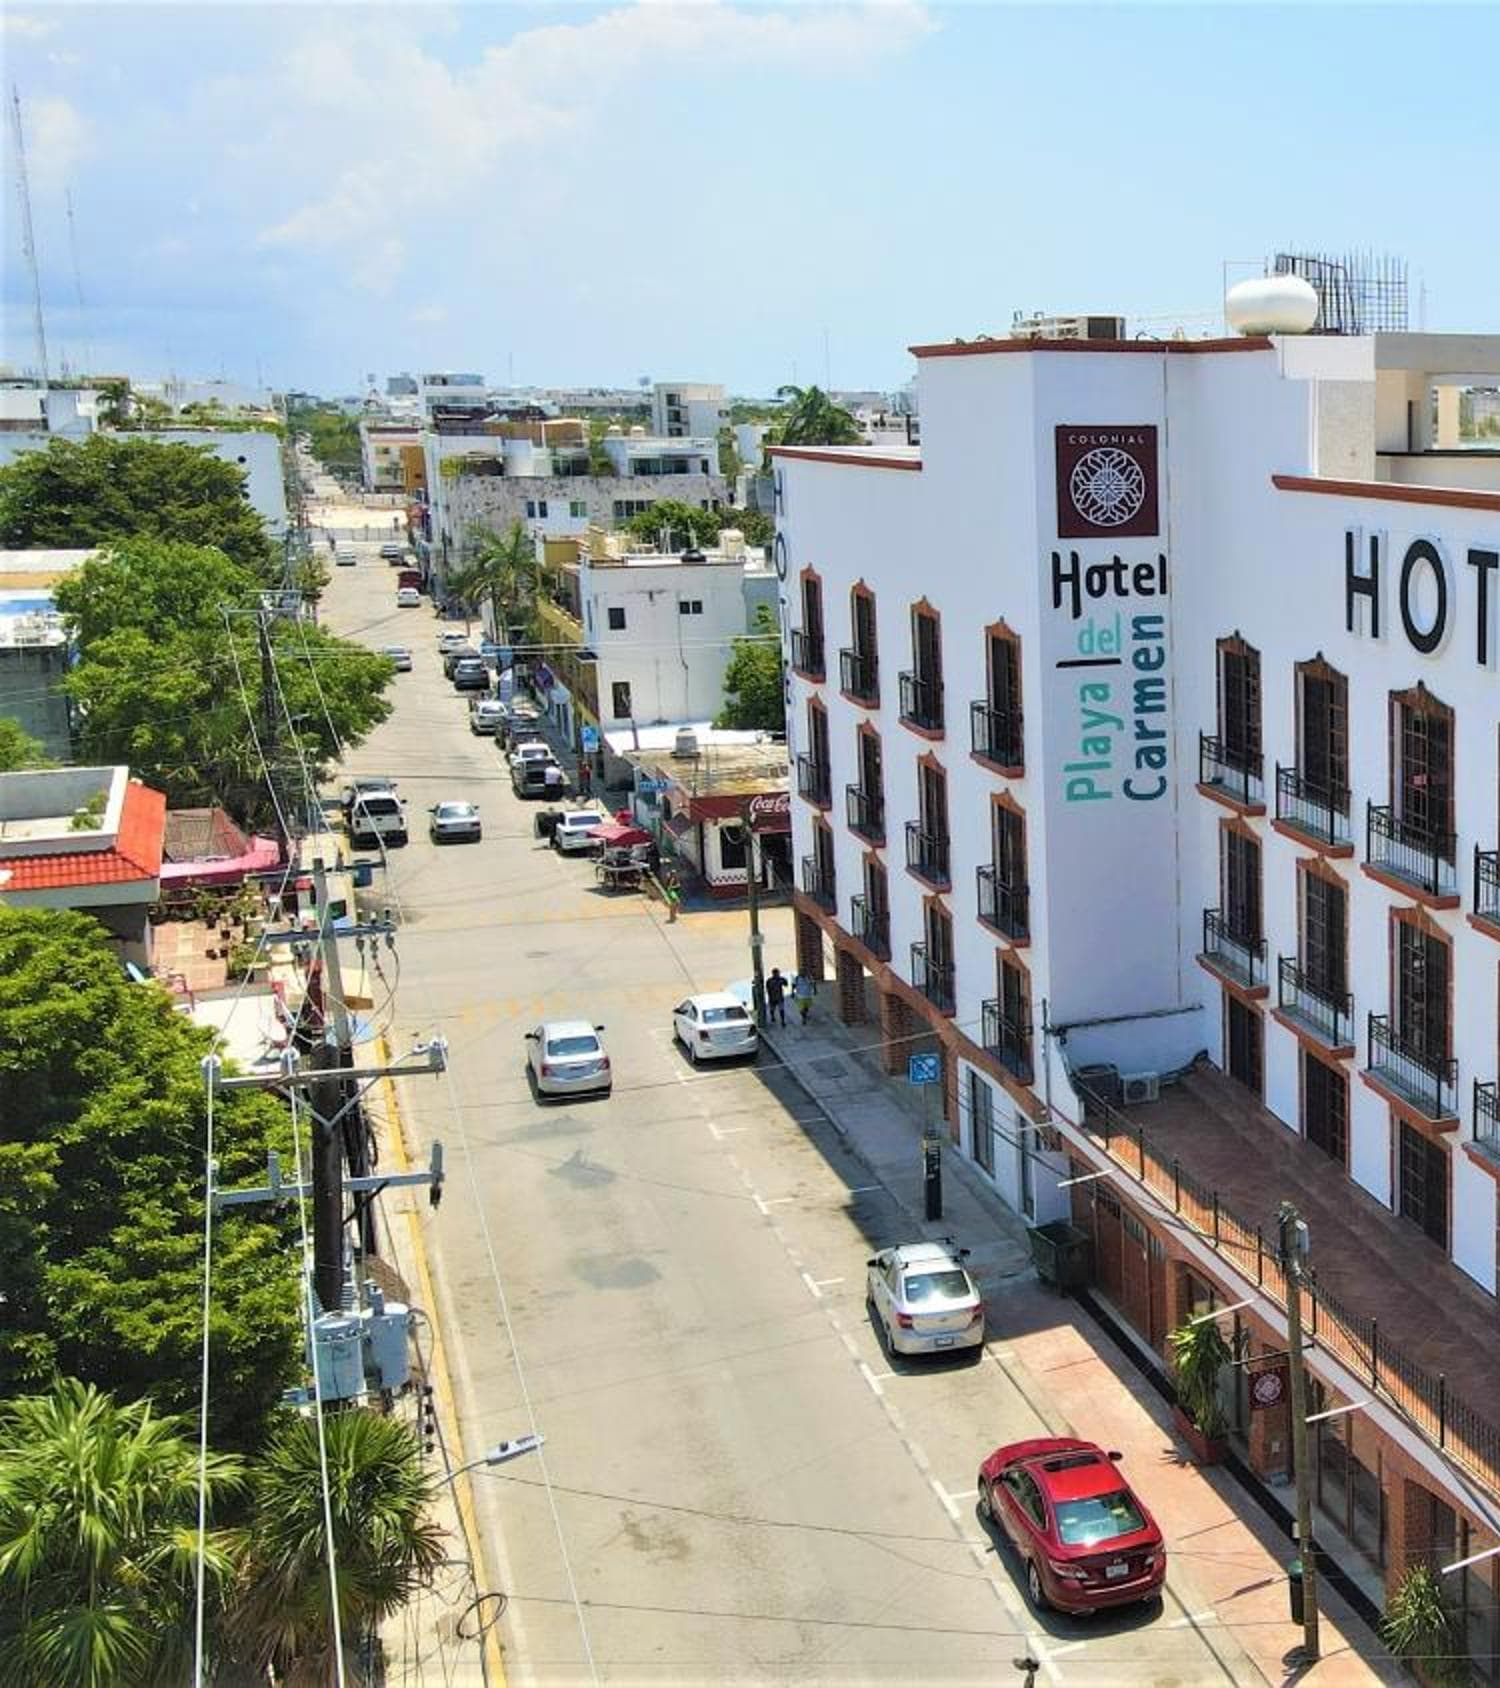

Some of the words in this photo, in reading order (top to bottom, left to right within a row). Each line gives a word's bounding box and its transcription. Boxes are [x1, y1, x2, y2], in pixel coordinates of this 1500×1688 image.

[1069, 434, 1145, 445] COLONIAL
[1052, 550, 1167, 619] Hotel
[1078, 612, 1121, 655] del
[1064, 682, 1125, 802] Playa
[1122, 615, 1167, 801] Carmen
